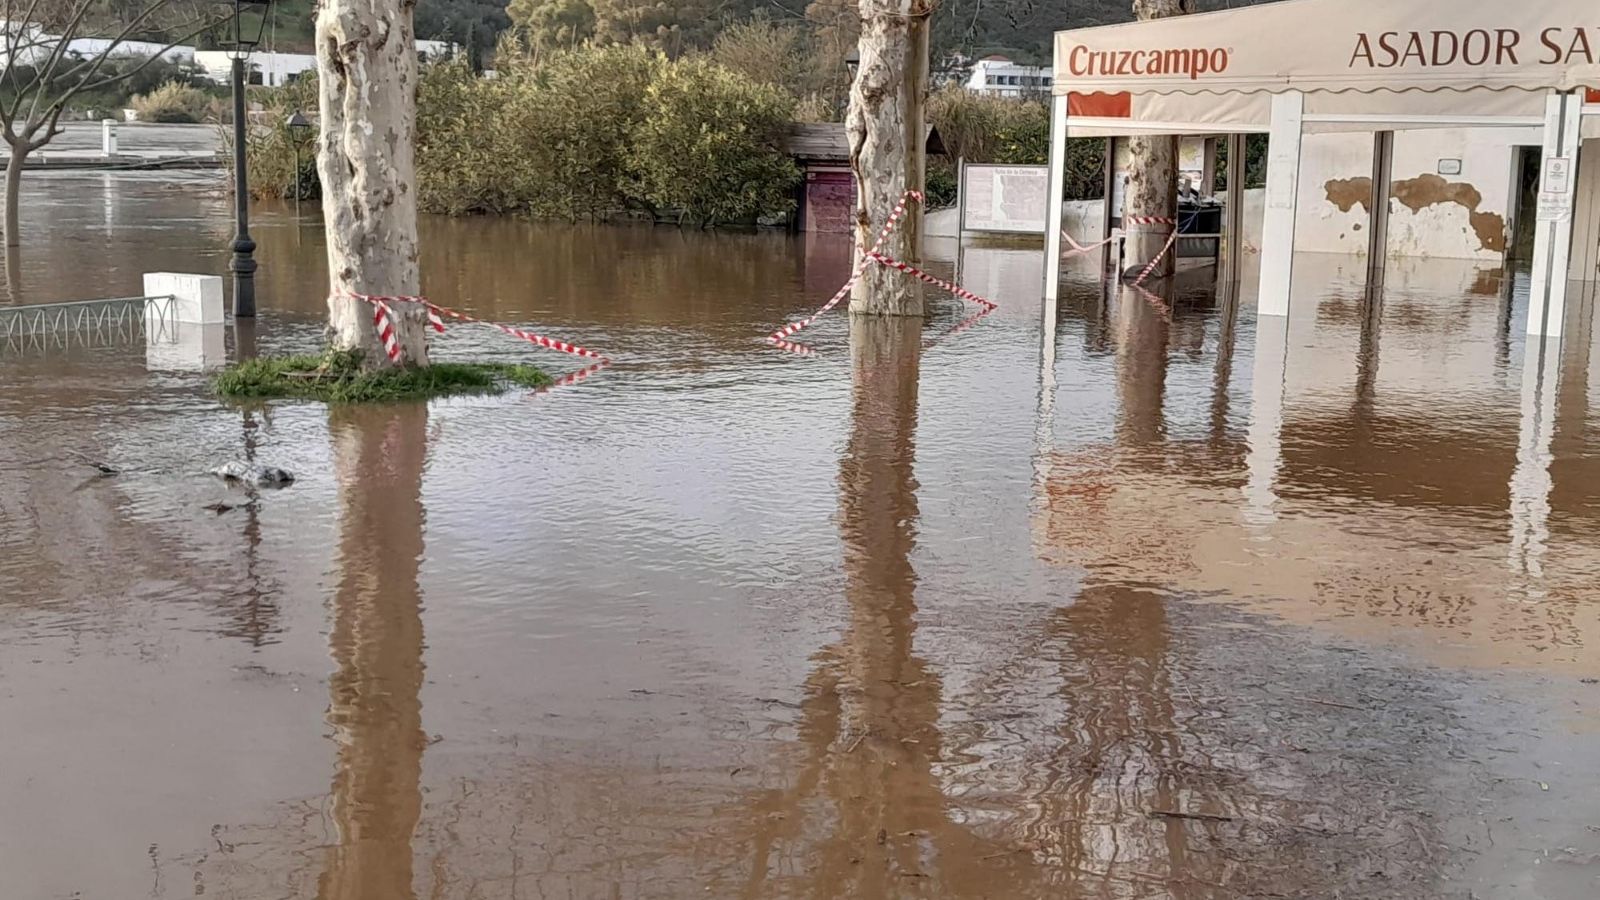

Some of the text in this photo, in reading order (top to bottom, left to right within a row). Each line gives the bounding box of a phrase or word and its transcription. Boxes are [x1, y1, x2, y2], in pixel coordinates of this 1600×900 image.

[1069, 45, 1228, 80] Cruzcampo
[1348, 27, 1600, 67] ASADOR SA
